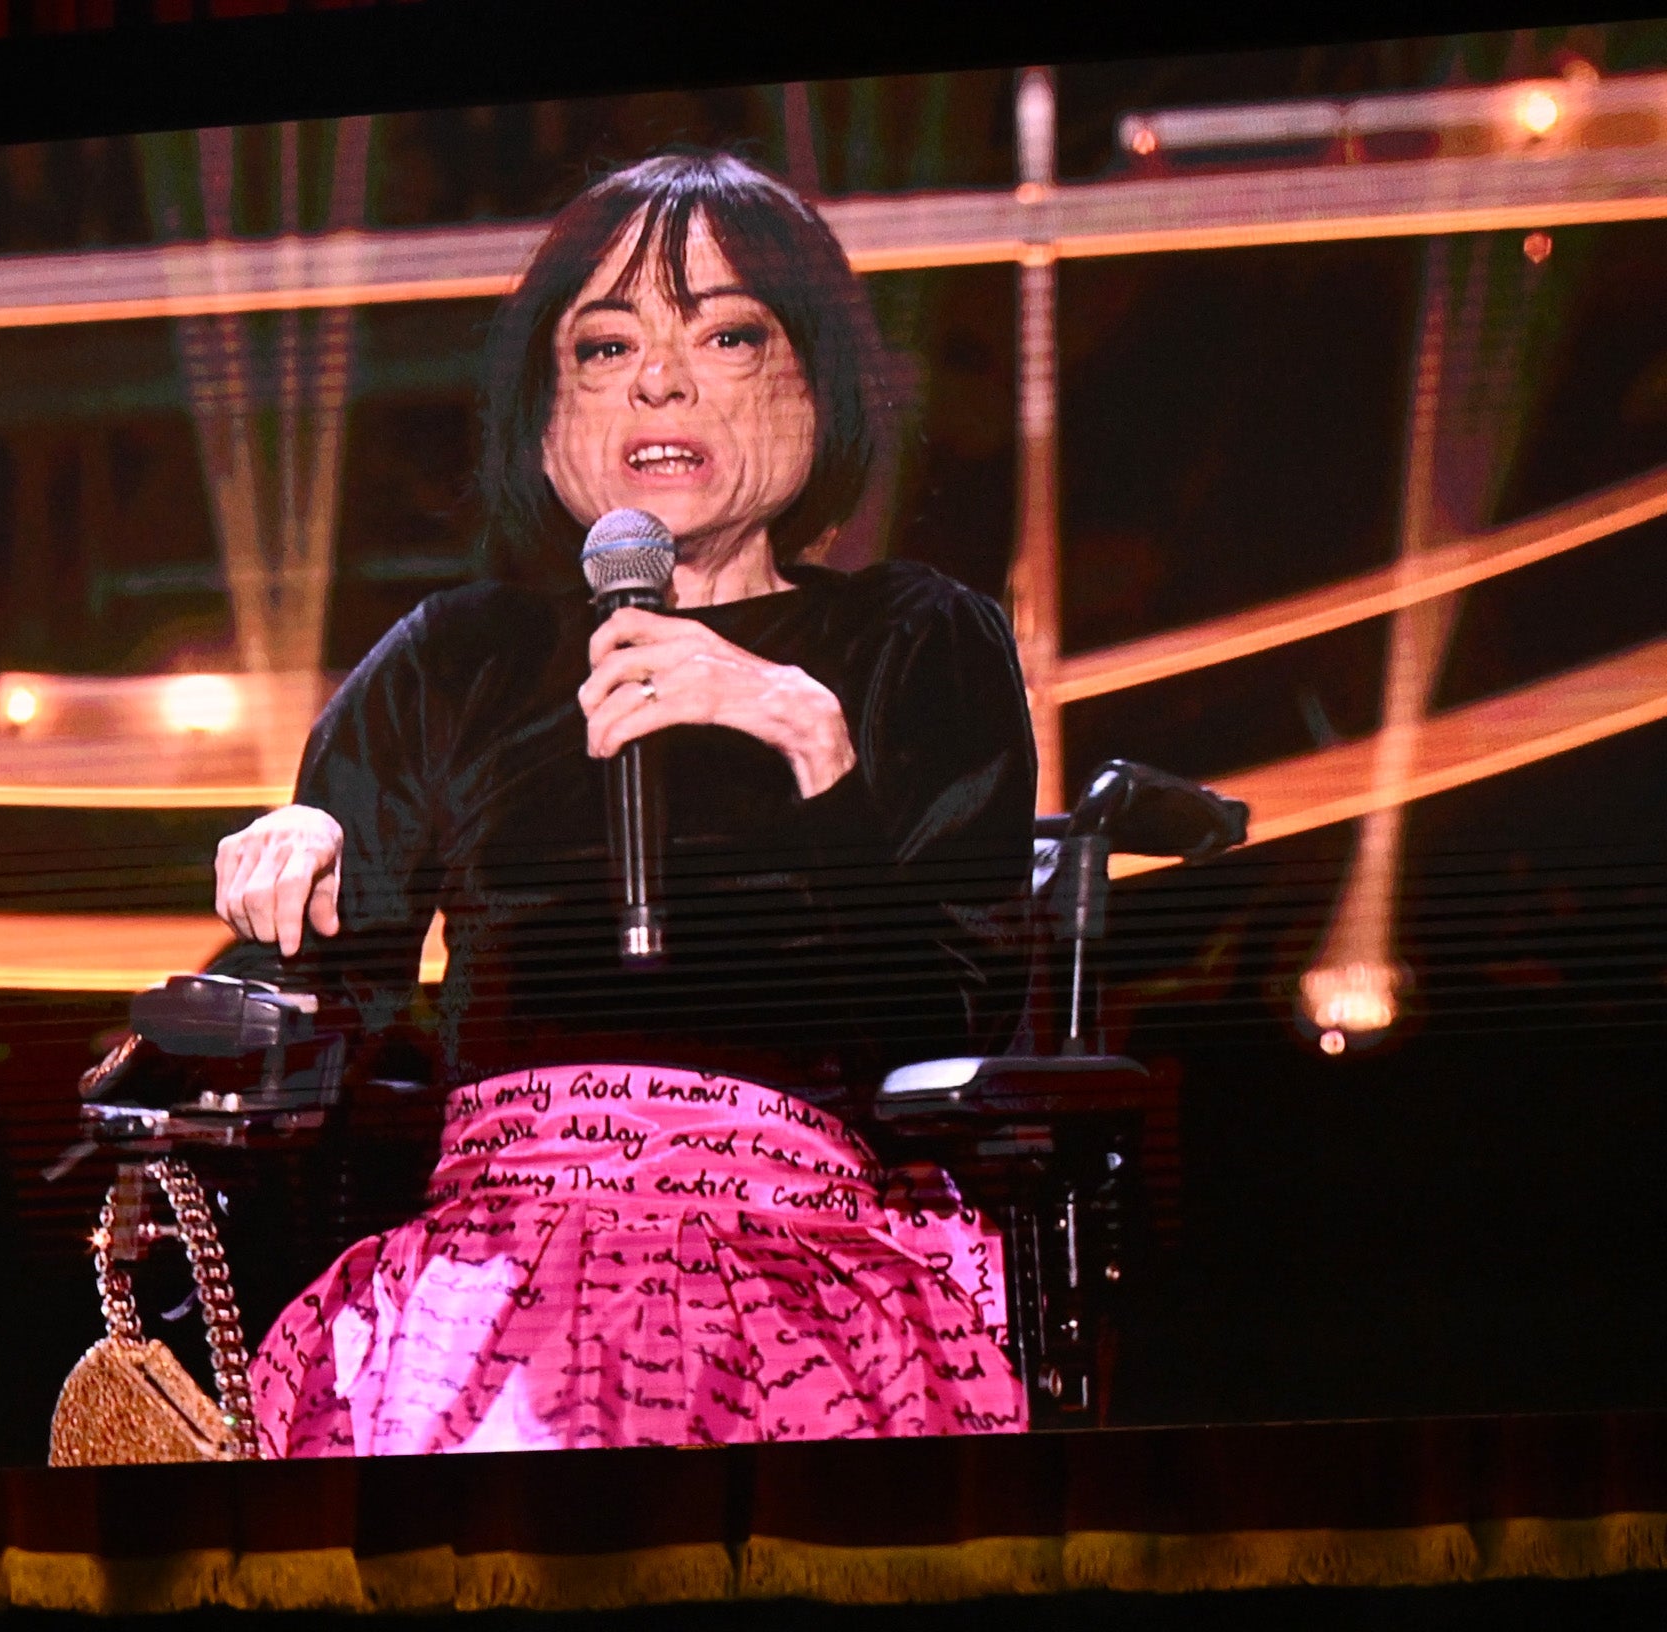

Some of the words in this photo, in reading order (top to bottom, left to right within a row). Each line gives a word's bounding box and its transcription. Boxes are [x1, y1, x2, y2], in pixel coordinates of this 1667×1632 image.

[494, 1070, 552, 1113] only
[569, 1071, 632, 1100] God
[648, 1076, 740, 1107] knows
[560, 1114, 648, 1162] delay
[670, 1129, 738, 1158] and
[654, 1168, 750, 1202] entire
